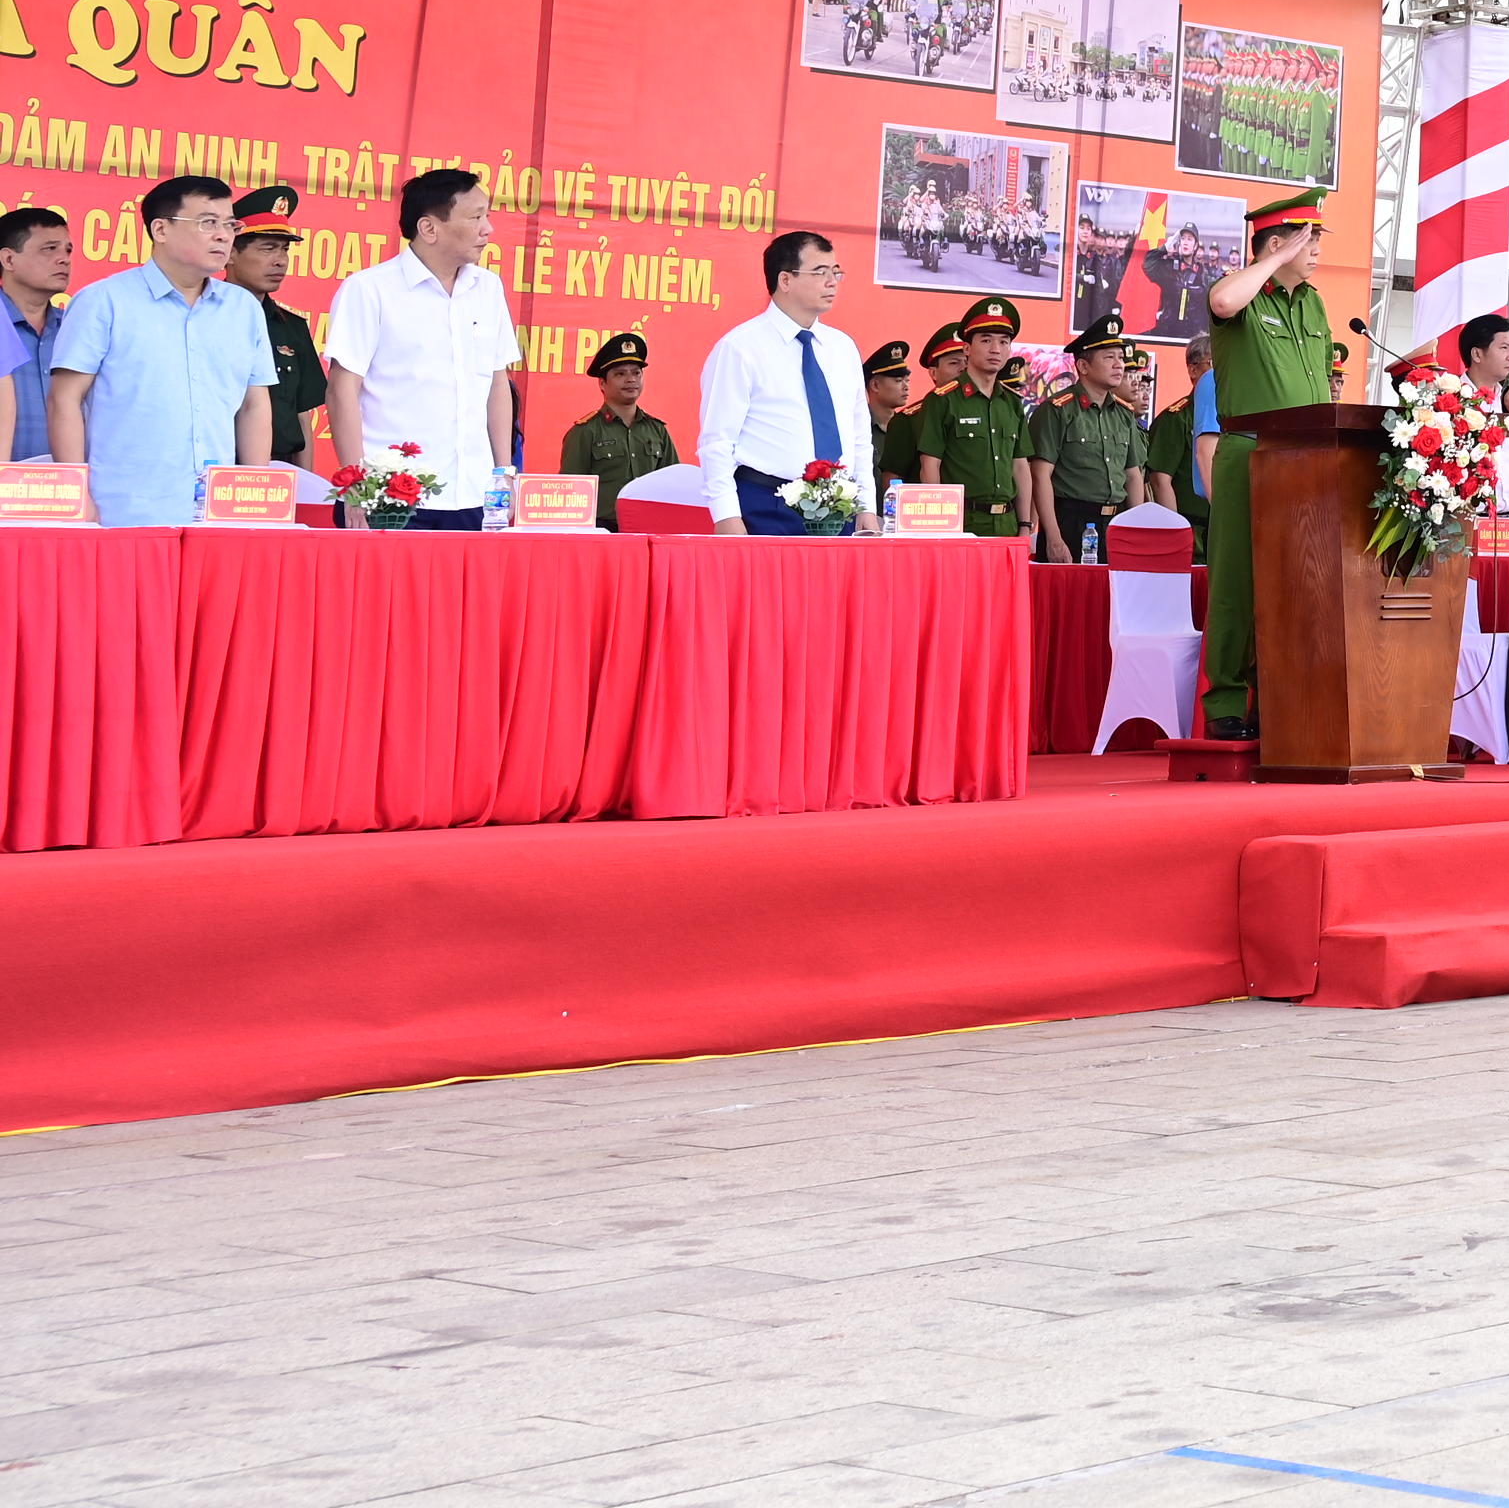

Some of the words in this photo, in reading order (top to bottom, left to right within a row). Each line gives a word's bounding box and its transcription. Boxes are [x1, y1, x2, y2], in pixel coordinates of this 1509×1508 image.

[97, 124, 162, 179] AN
[303, 140, 400, 211] TRẬT
[468, 148, 542, 215] BẢO
[554, 162, 597, 229] VỆ
[608, 171, 711, 237] TUYỆT
[718, 172, 777, 234] ĐỐI
[1084, 186, 1114, 203] VOV
[513, 229, 555, 295] LỄ
[565, 235, 613, 298] KỶ
[621, 246, 721, 312] NIỆM,
[234, 487, 265, 502] QUANG
